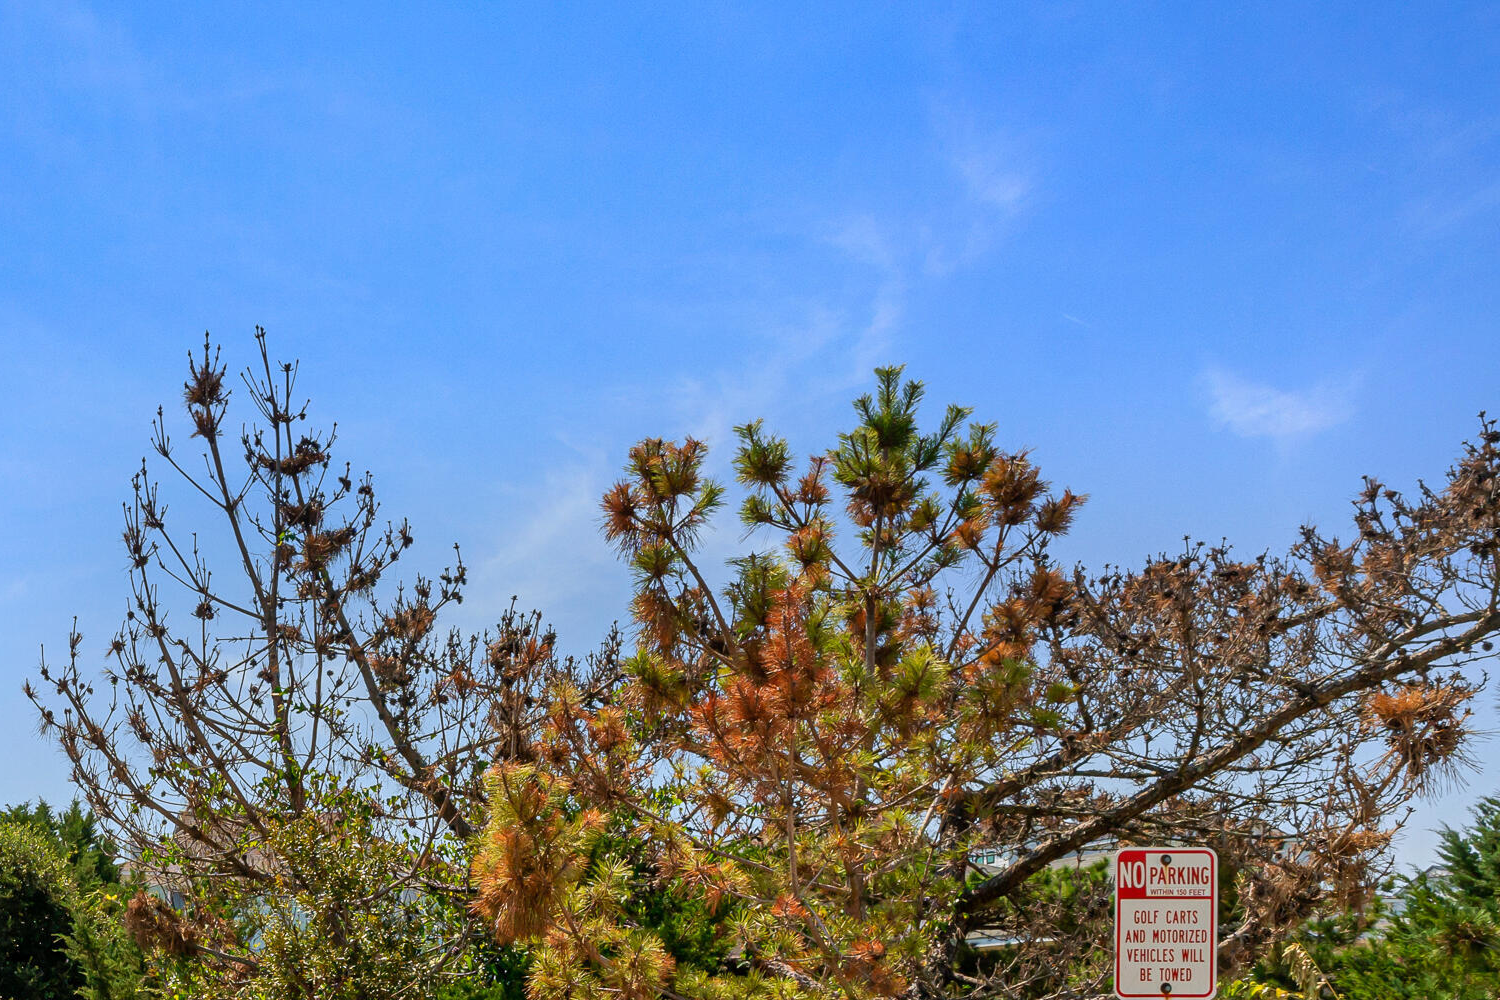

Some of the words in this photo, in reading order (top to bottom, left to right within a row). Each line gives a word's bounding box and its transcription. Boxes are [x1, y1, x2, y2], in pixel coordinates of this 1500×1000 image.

[1119, 861, 1146, 889] NO
[1150, 866, 1209, 885] PARKING
[1133, 910, 1159, 924] GOLF
[1166, 910, 1198, 924] CARTS
[1125, 930, 1146, 943] AND
[1152, 930, 1207, 943] MOTORIZED
[1126, 949, 1175, 962] VEHICLES
[1181, 949, 1205, 962] WILL
[1140, 968, 1152, 981] BE
[1159, 968, 1192, 981] TOWED
